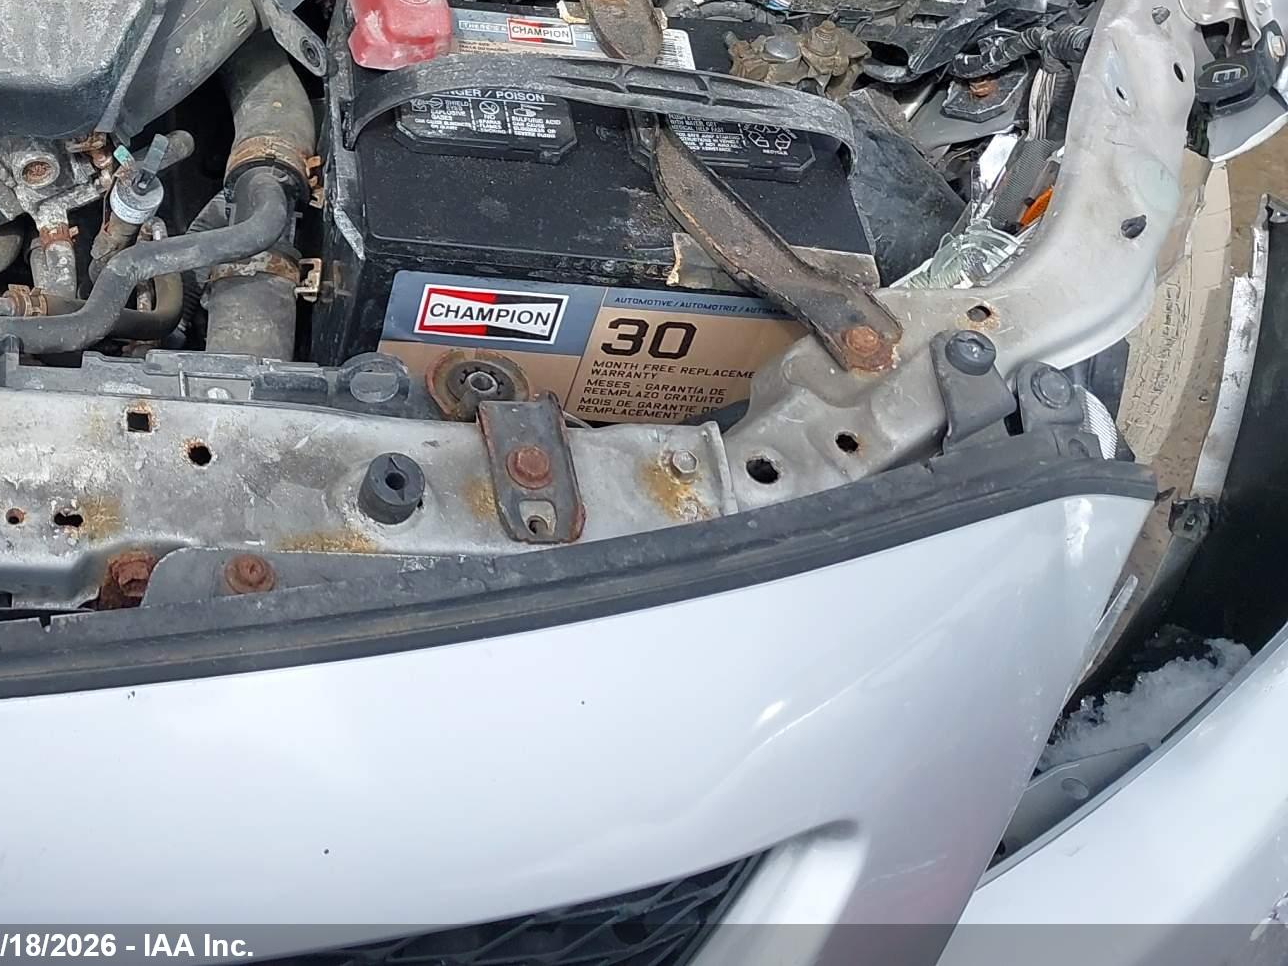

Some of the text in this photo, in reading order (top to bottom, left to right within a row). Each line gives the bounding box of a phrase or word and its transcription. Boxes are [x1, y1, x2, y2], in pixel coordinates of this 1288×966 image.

[512, 25, 571, 39] CHAMPION
[496, 90, 545, 102] POISON
[614, 297, 674, 307] AUTOMOTIVE
[680, 300, 738, 313] AUTOMOTRIZ
[429, 302, 551, 326] CHAMPION
[601, 317, 697, 360] 30
[591, 368, 658, 380] WARRANTY
[593, 360, 756, 379] MONTH FREE REPLACEME
[586, 378, 630, 389] MESES
[645, 383, 704, 395] GARANTÍA
[709, 388, 727, 396] DE
[583, 387, 724, 404] REEMPLAZO GRATUITO
[576, 405, 680, 420] REMPLACEMENT
[579, 397, 612, 406] MOIS
[616, 400, 633, 408] DE
[637, 402, 696, 413] GARANTIE
